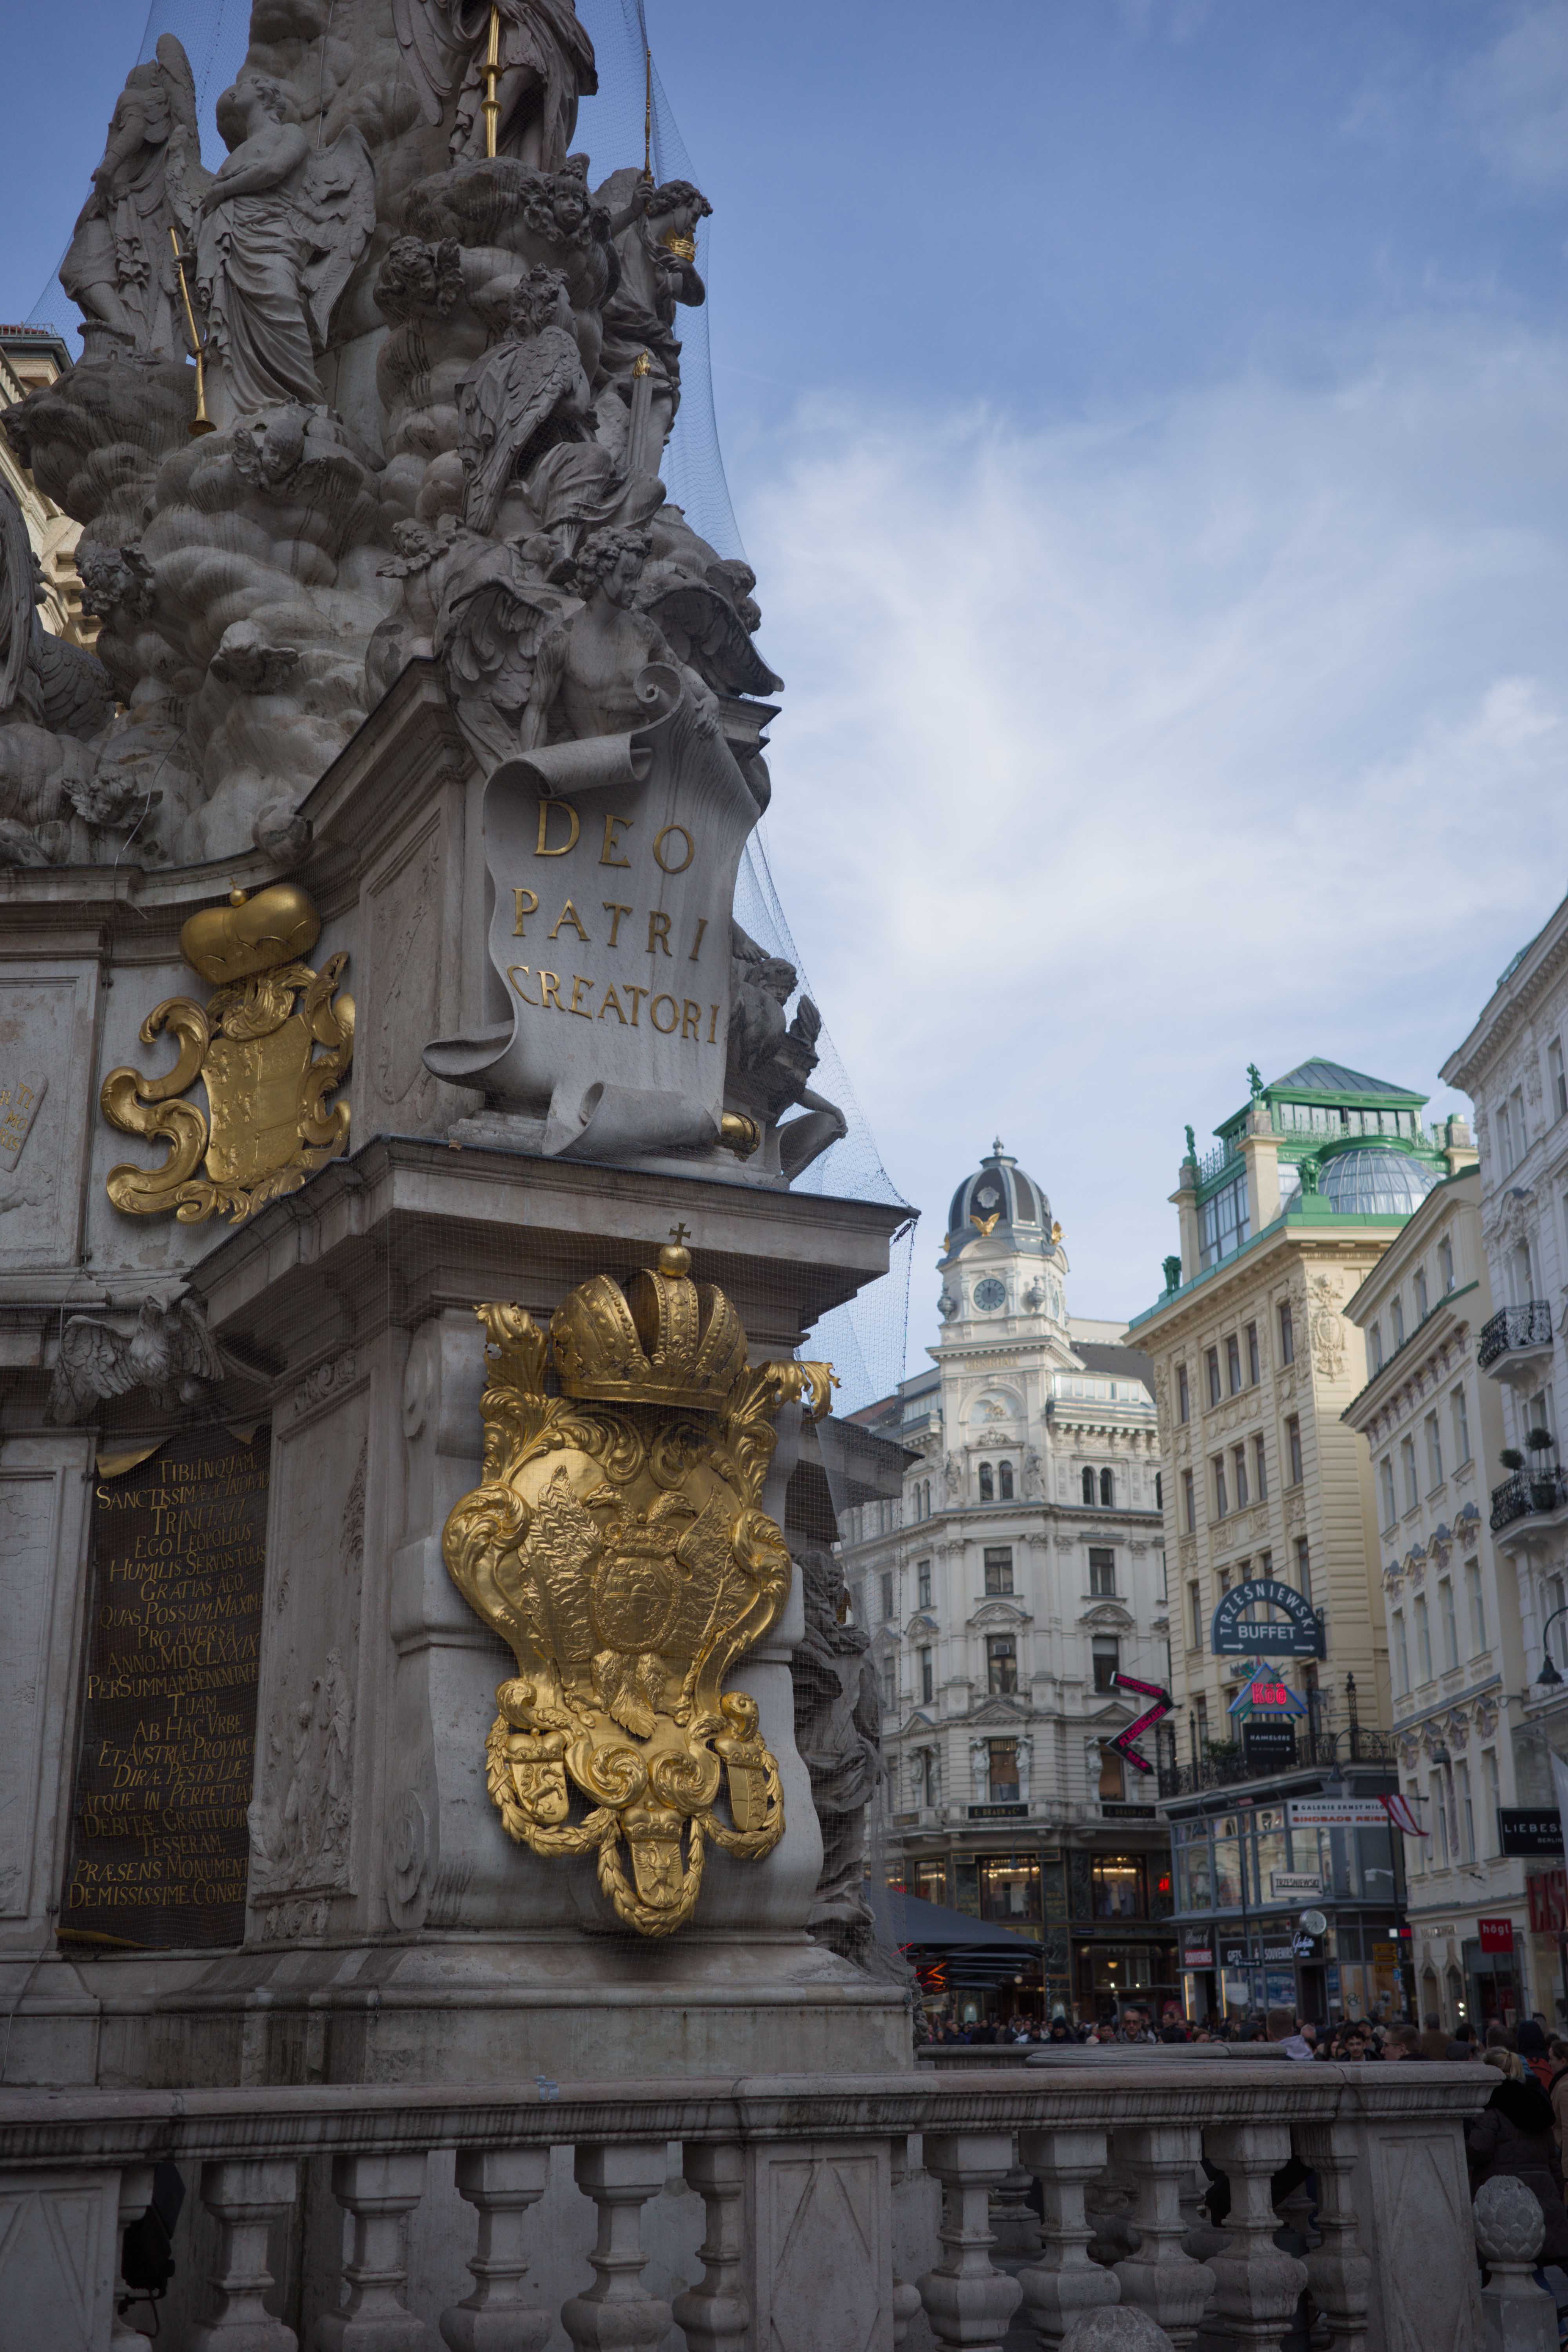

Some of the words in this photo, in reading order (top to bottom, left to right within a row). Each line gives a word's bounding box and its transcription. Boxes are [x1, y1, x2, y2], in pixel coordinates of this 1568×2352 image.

[534, 800, 695, 873] DEO
[512, 888, 708, 961] PATRI
[507, 965, 720, 1044] CREATORI
[151, 1499, 246, 1535] TRINITATI
[134, 1536, 172, 1559] EGO
[177, 1523, 254, 1553] LEOPOLDUS
[110, 1558, 181, 1582] HUMILIS
[185, 1551, 234, 1575] SERVUS
[234, 1544, 266, 1567] TUUS
[141, 1577, 212, 1601] GRATIAS
[100, 1605, 141, 1630] QUAS
[138, 1626, 170, 1649] PRO
[175, 1623, 236, 1645] AVERSA
[1238, 1625, 1296, 1639] BUFFET
[160, 1633, 260, 1671] MDCLXXIX
[87, 1675, 119, 1699] PER
[118, 1674, 189, 1697] SUMMAM
[1251, 1682, 1287, 1704] Köö
[167, 1693, 217, 1717] TUAM
[132, 1719, 160, 1743] AB
[165, 1716, 203, 1740] HAC
[208, 1712, 243, 1737] VRBE
[1118, 1704, 1167, 1748] FLEDERMAUS
[98, 1740, 127, 1767] ET
[165, 1762, 216, 1784] PESTIS
[78, 1791, 135, 1816] ATQUE
[144, 1791, 160, 1810] IN
[69, 1882, 189, 1908] DEMISSISSIME
[1483, 1923, 1510, 1936] högl
[1185, 1950, 1212, 1964] SOUVENIRS
[1264, 1947, 1293, 1960] SOUVENIRS
